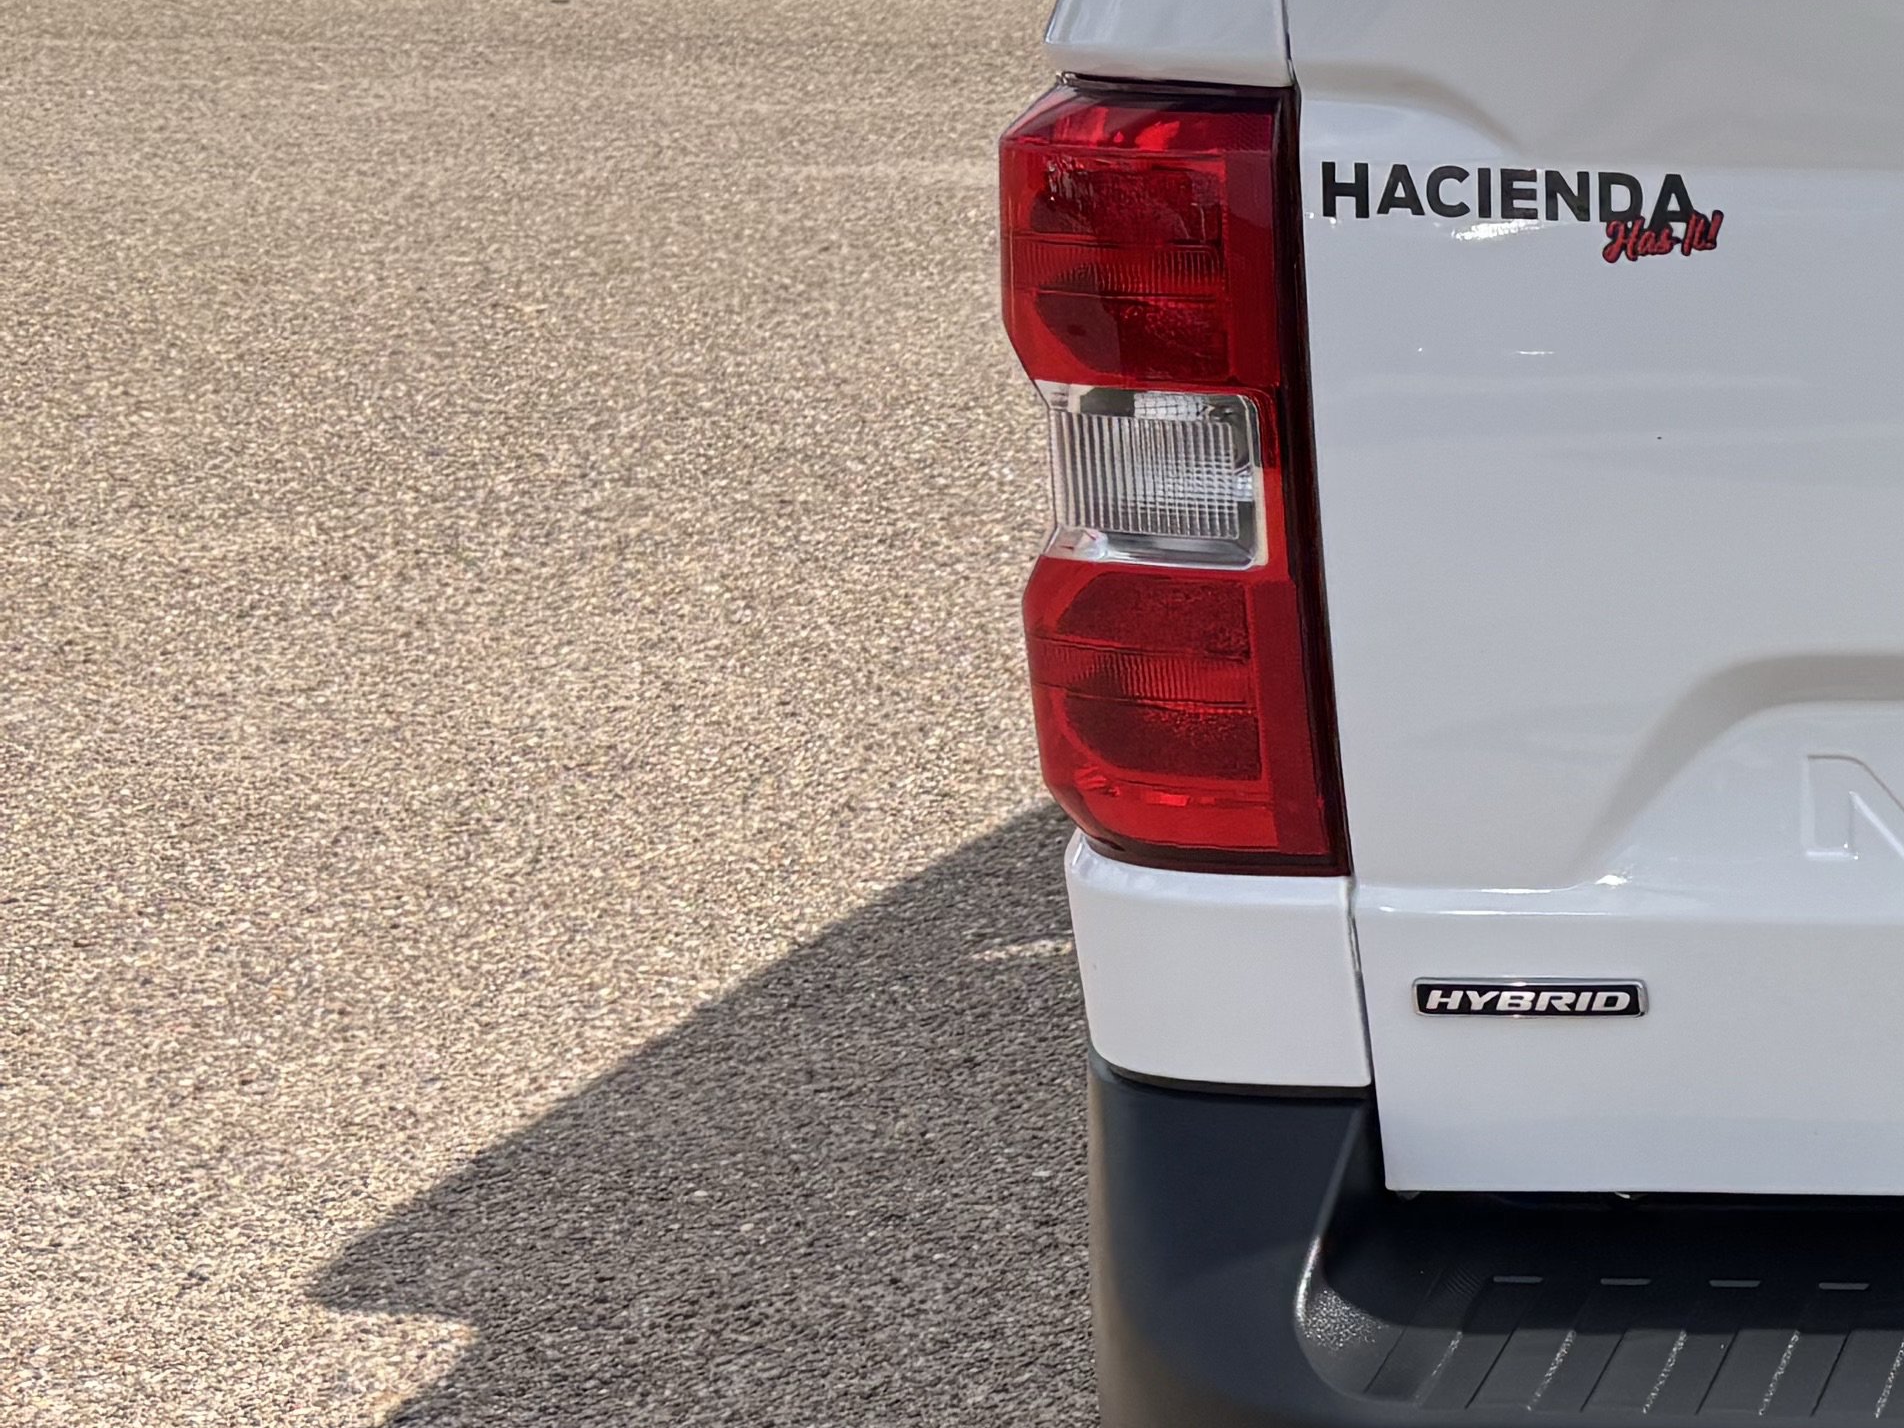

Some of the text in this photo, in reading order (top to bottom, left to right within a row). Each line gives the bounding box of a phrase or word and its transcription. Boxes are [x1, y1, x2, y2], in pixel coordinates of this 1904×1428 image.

[1321, 161, 1697, 230] HACIENDA
[1602, 216, 1680, 264] Has
[1425, 989, 1631, 1012] HYBRID
